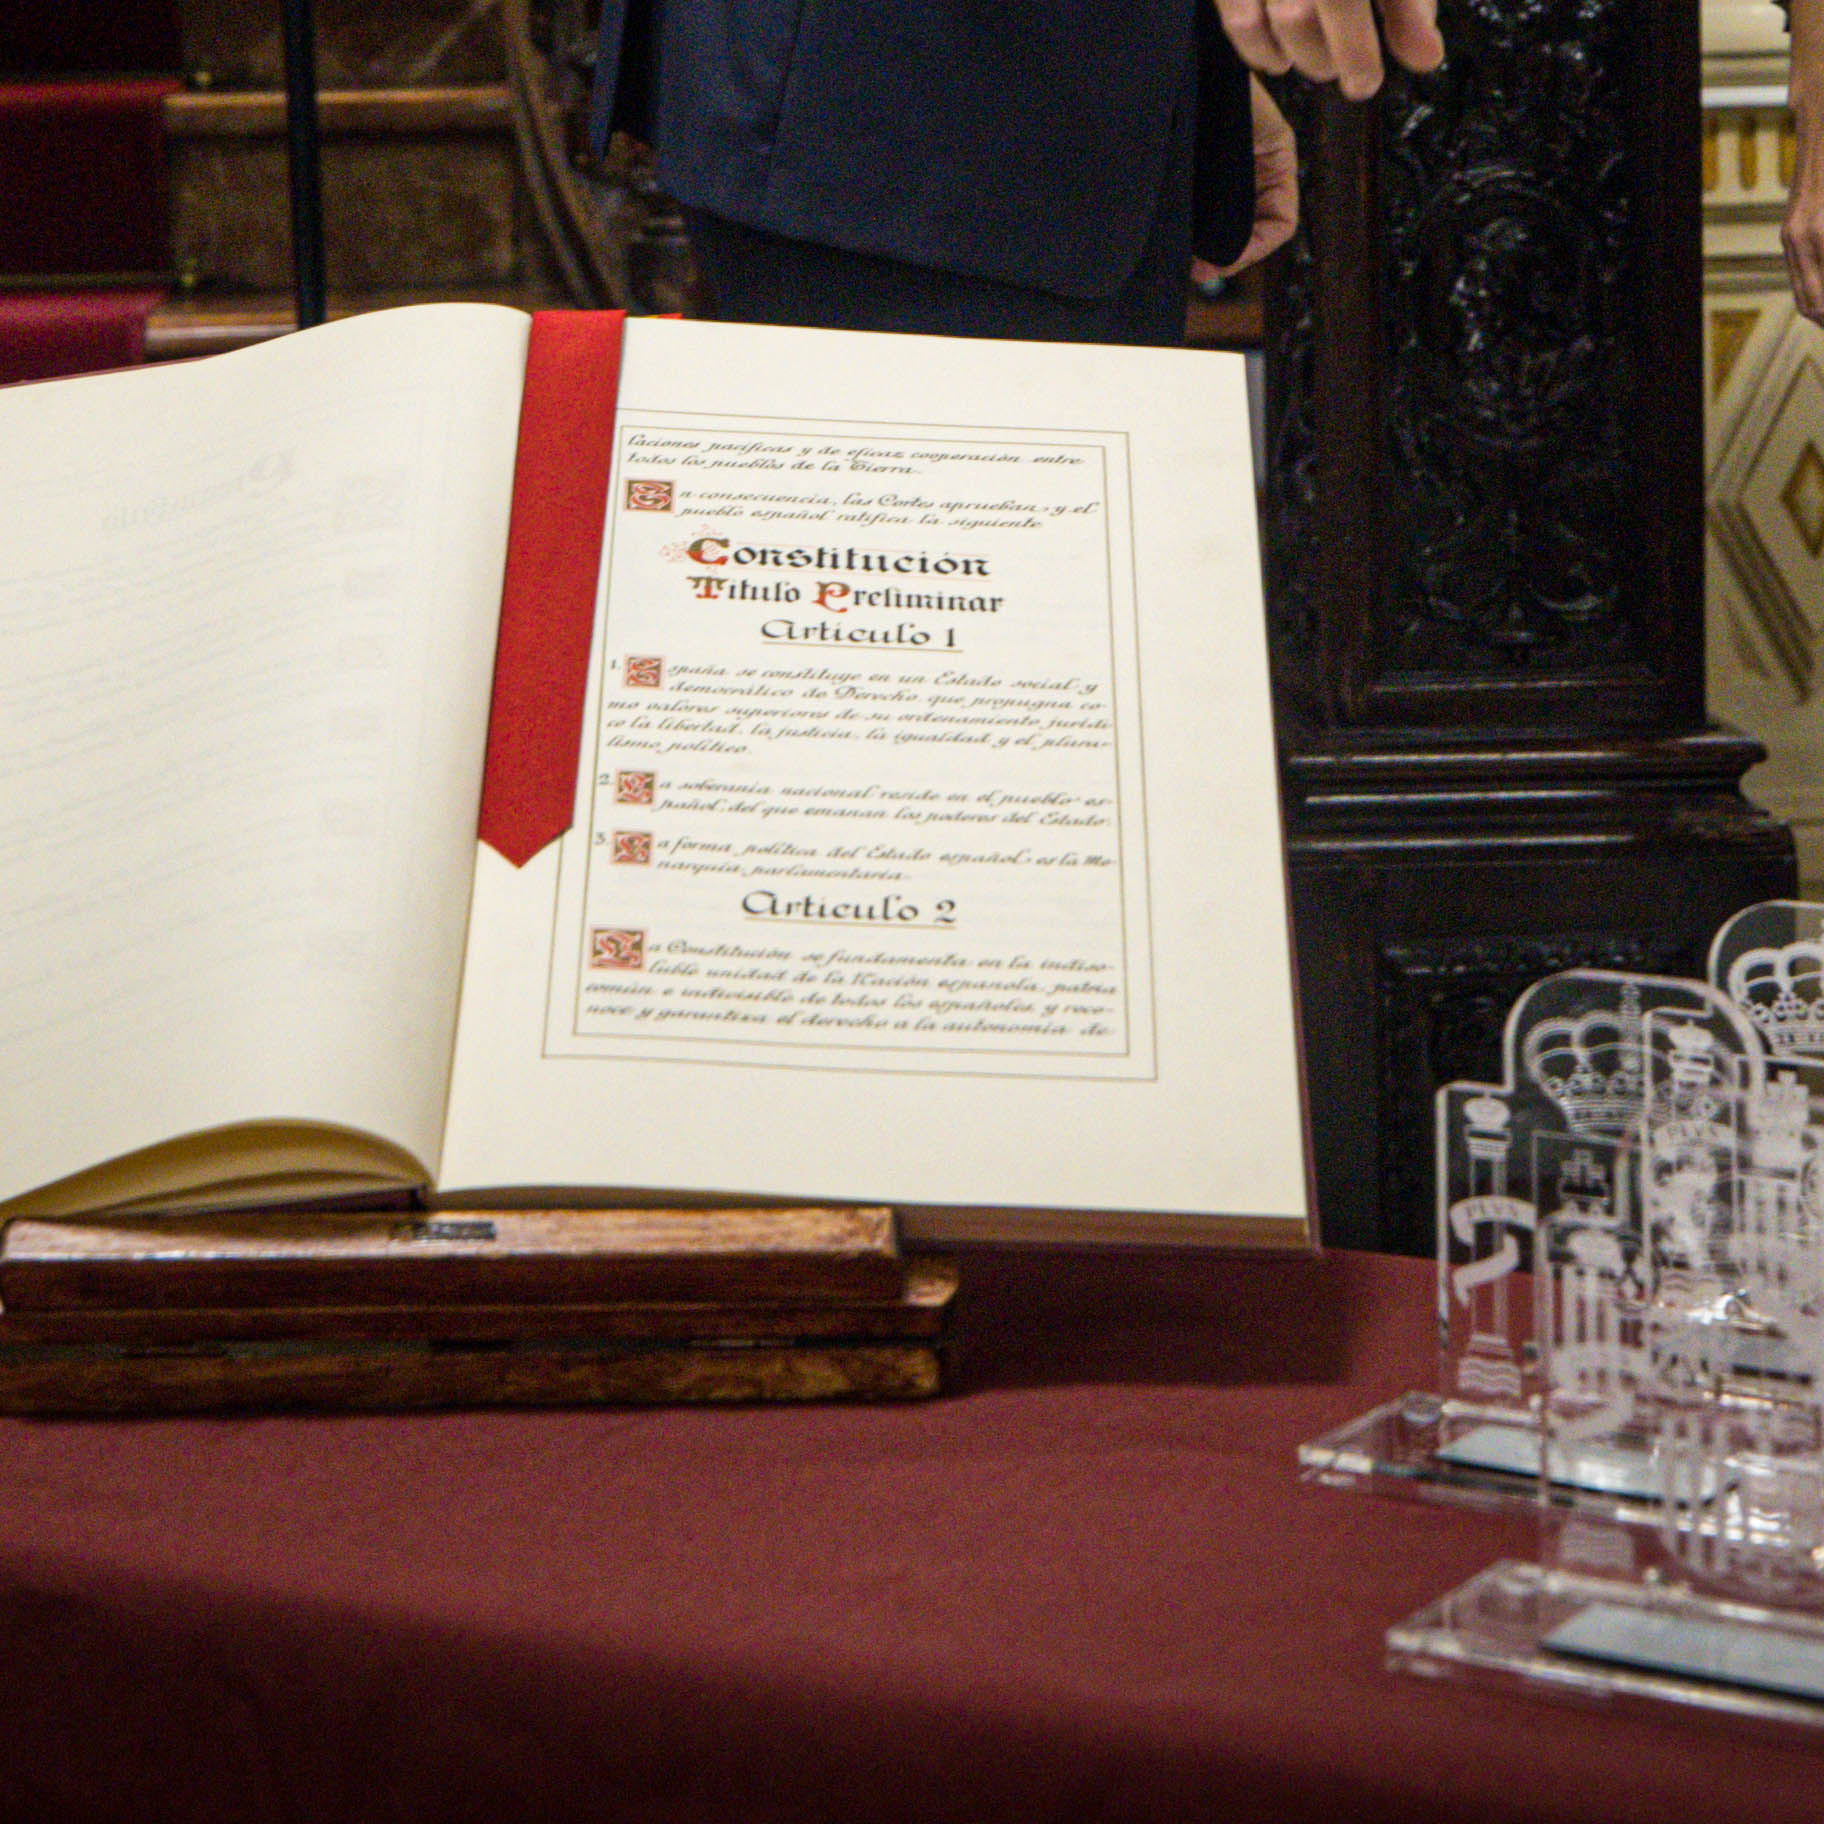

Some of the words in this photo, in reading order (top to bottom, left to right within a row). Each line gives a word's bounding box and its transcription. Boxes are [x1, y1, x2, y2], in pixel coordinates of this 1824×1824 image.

[797, 445, 812, 457] y
[790, 460, 815, 471] de
[685, 536, 992, 577] Constitución
[812, 581, 1005, 613] Preliminar
[945, 627, 958, 649] 1
[934, 898, 957, 924] 2
